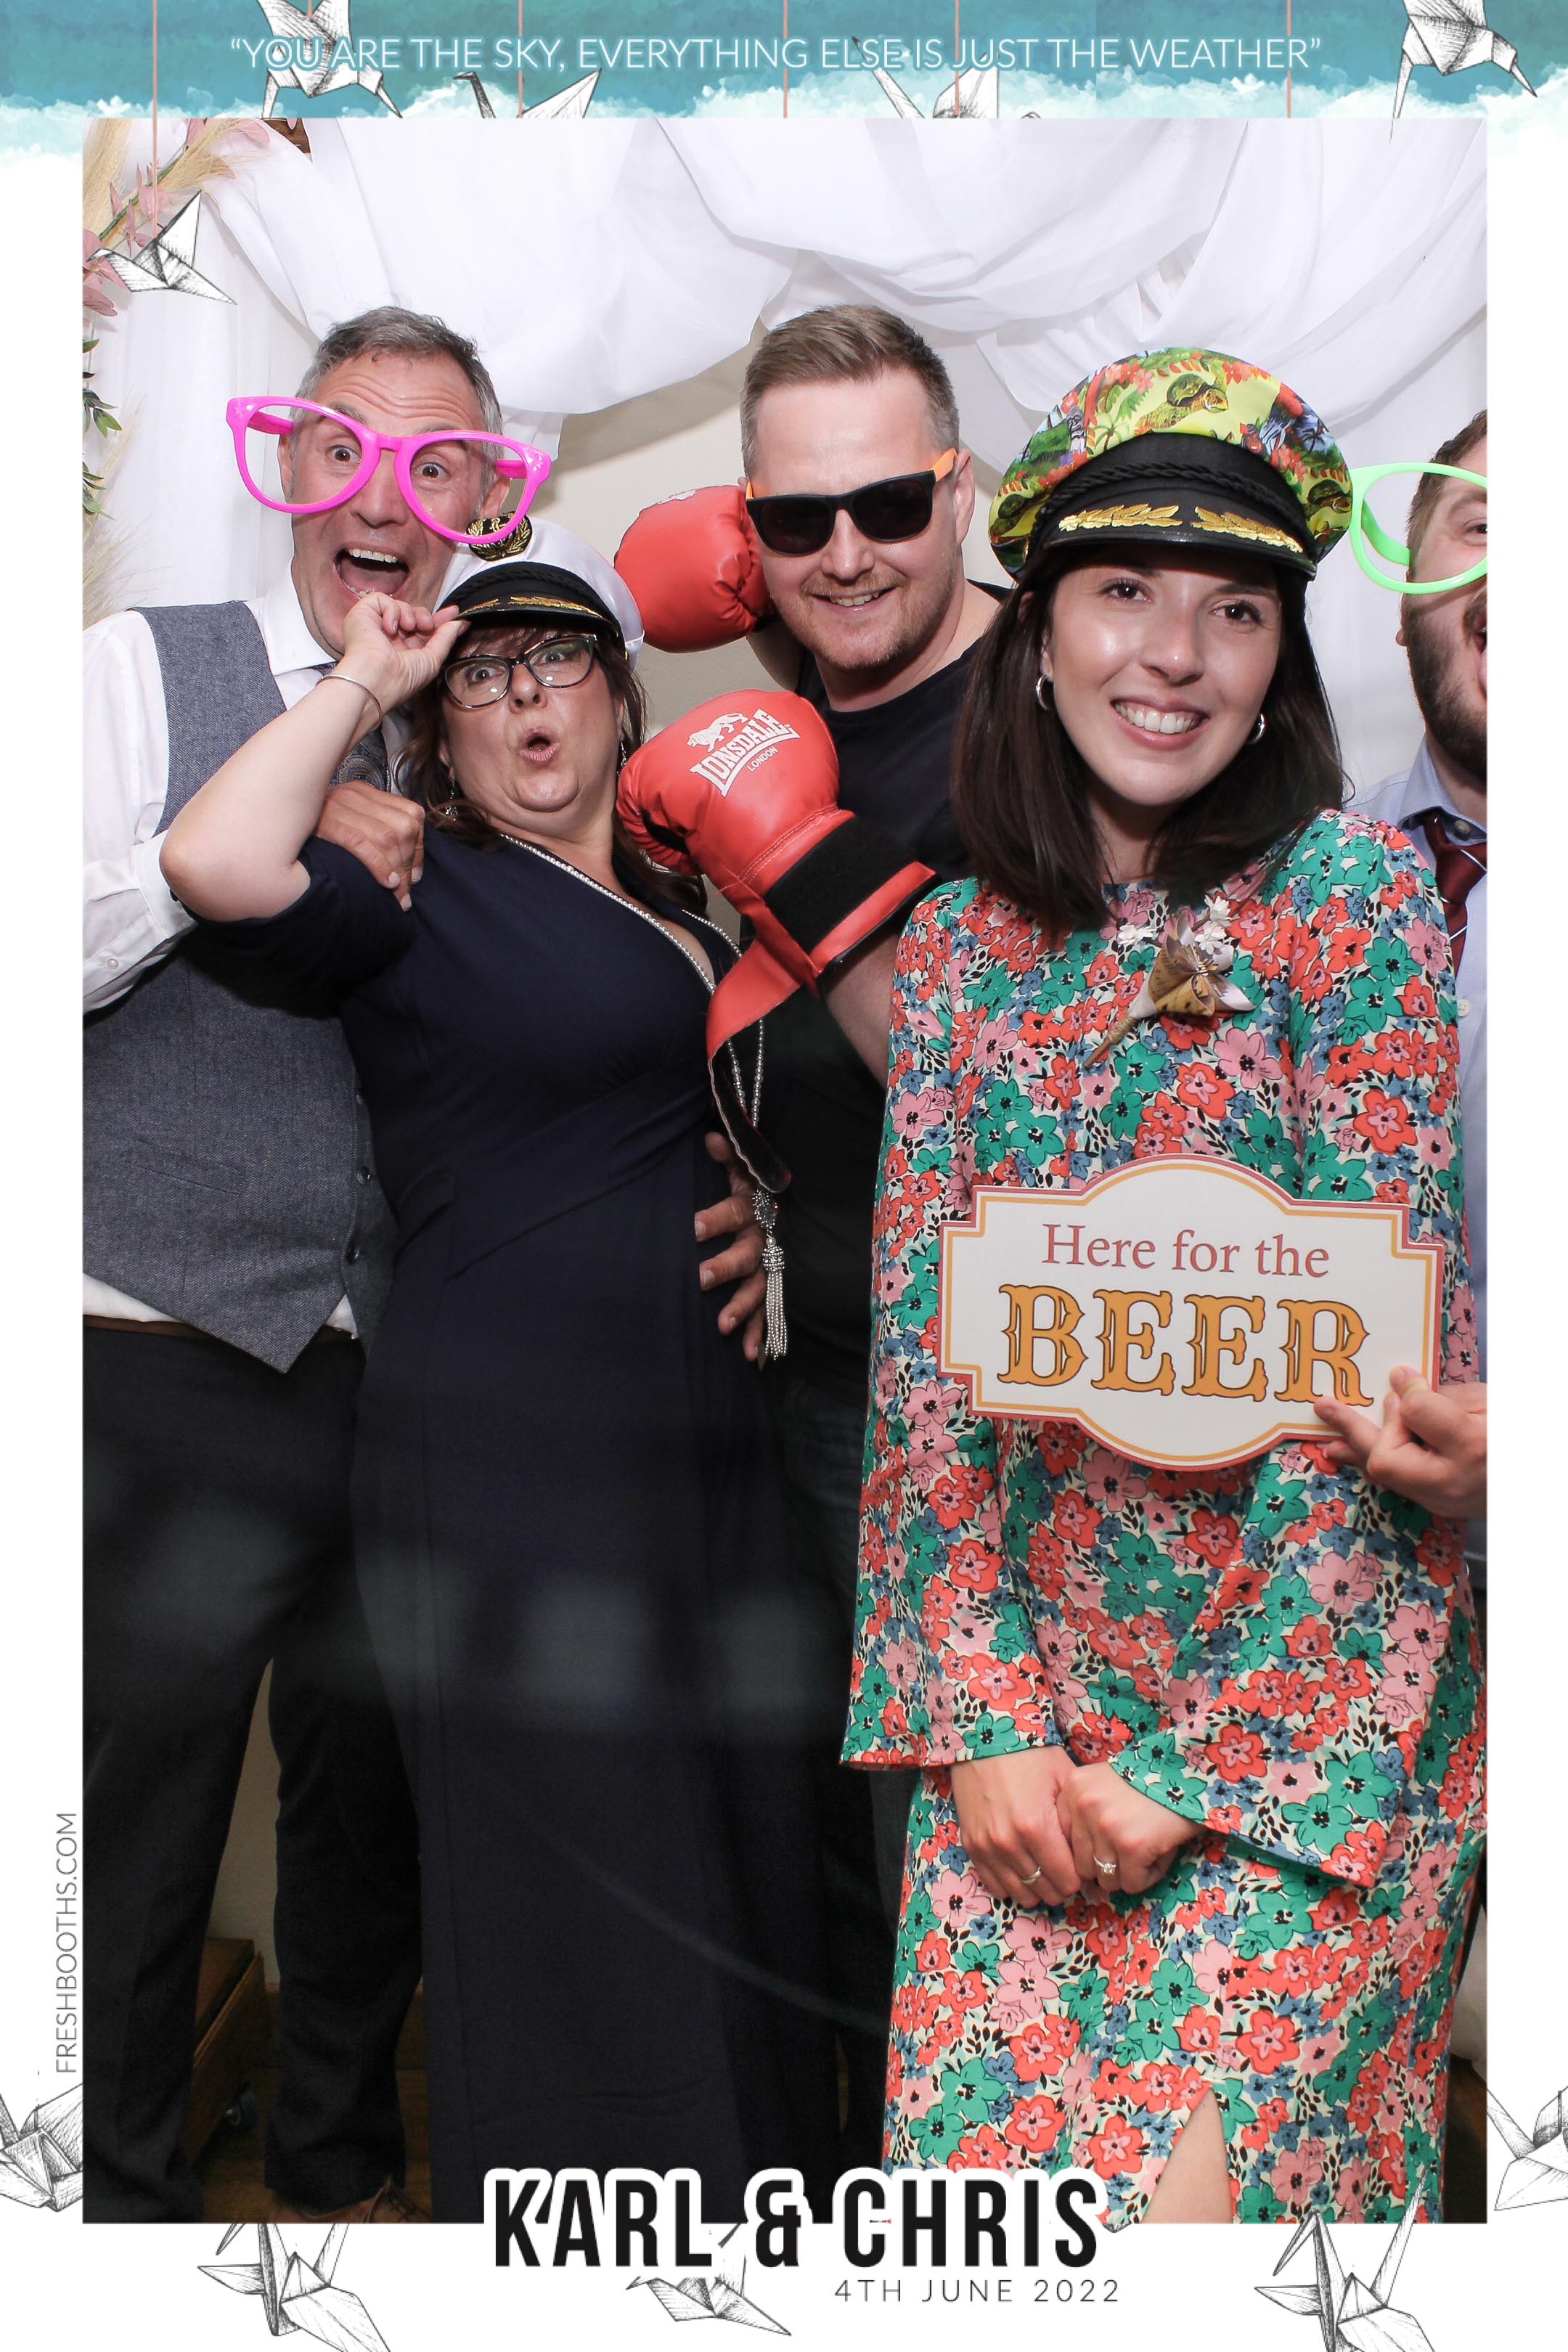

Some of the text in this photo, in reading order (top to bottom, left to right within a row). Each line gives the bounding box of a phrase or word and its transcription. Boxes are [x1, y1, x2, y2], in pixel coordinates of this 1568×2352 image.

[690, 709, 801, 797] LONSDALE
[746, 746, 778, 772] LONDON
[1042, 1223, 1330, 1278] Here for the
[996, 1284, 1373, 1407] BEER
